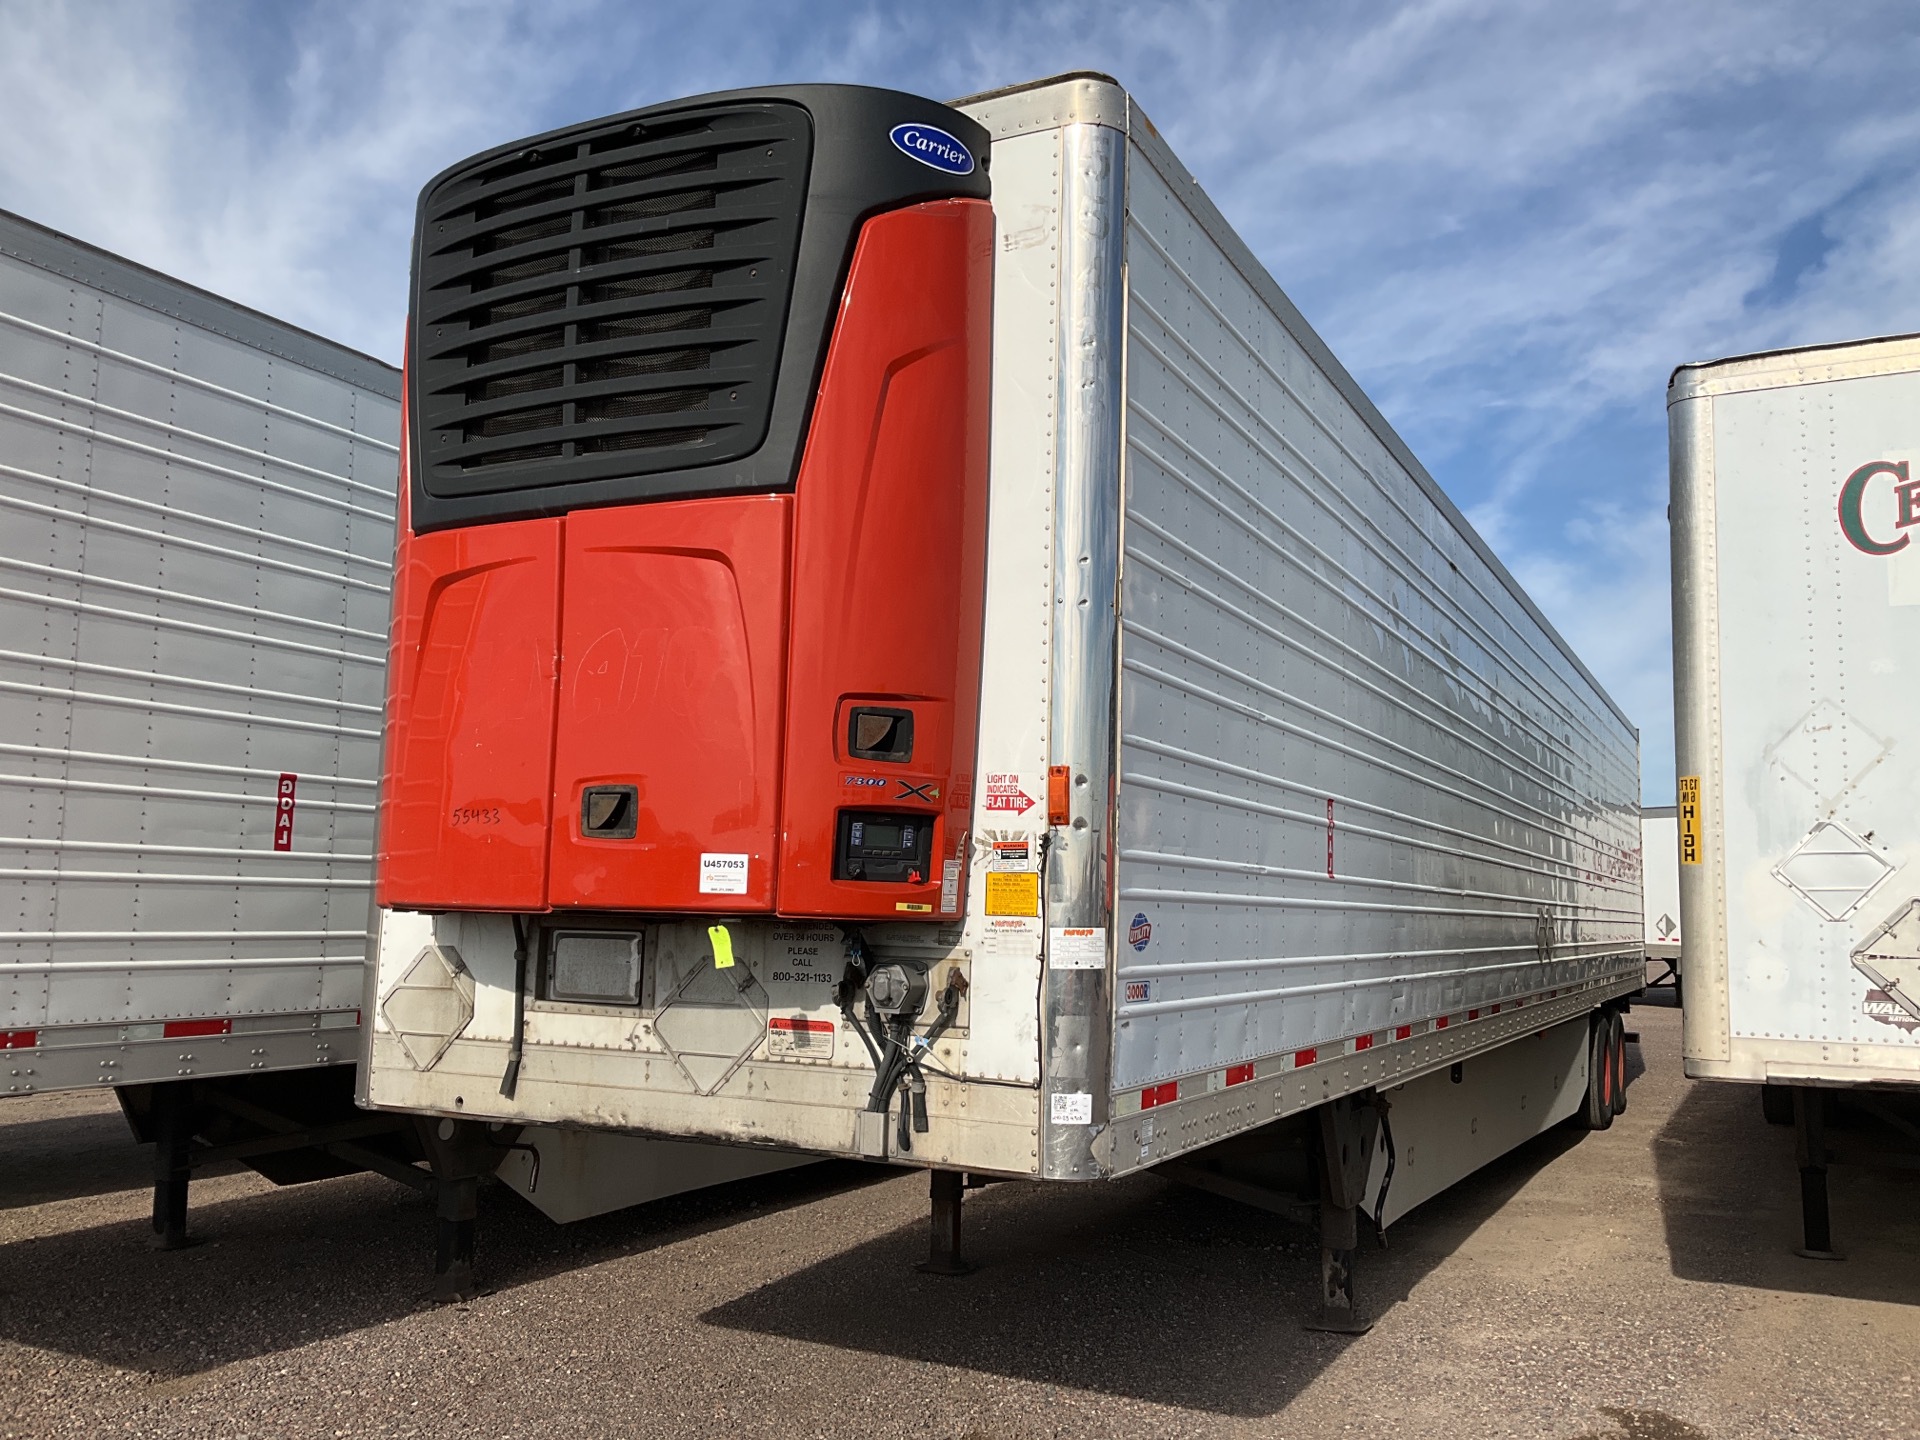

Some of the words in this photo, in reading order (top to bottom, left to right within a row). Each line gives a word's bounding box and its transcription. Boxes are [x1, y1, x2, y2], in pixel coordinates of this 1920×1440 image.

[903, 131, 966, 165] Carrier
[845, 776, 887, 787] 7300
[987, 774, 1008, 784] LIGHT
[1009, 774, 1019, 784] ON
[987, 784, 1018, 794] INDICATES
[987, 796, 1008, 808] FLAT
[1008, 796, 1028, 809] TIRE
[451, 808, 502, 827] 55433
[704, 860, 745, 869] U457053
[773, 932, 794, 941] OVER
[796, 933, 805, 941] 24
[806, 933, 835, 942] HOURS
[1130, 926, 1150, 942] UTILITY
[788, 947, 819, 956] PLEASE
[792, 958, 813, 967] CALL
[772, 971, 832, 983] 800-321-1133
[1127, 983, 1149, 1000] 3000R
